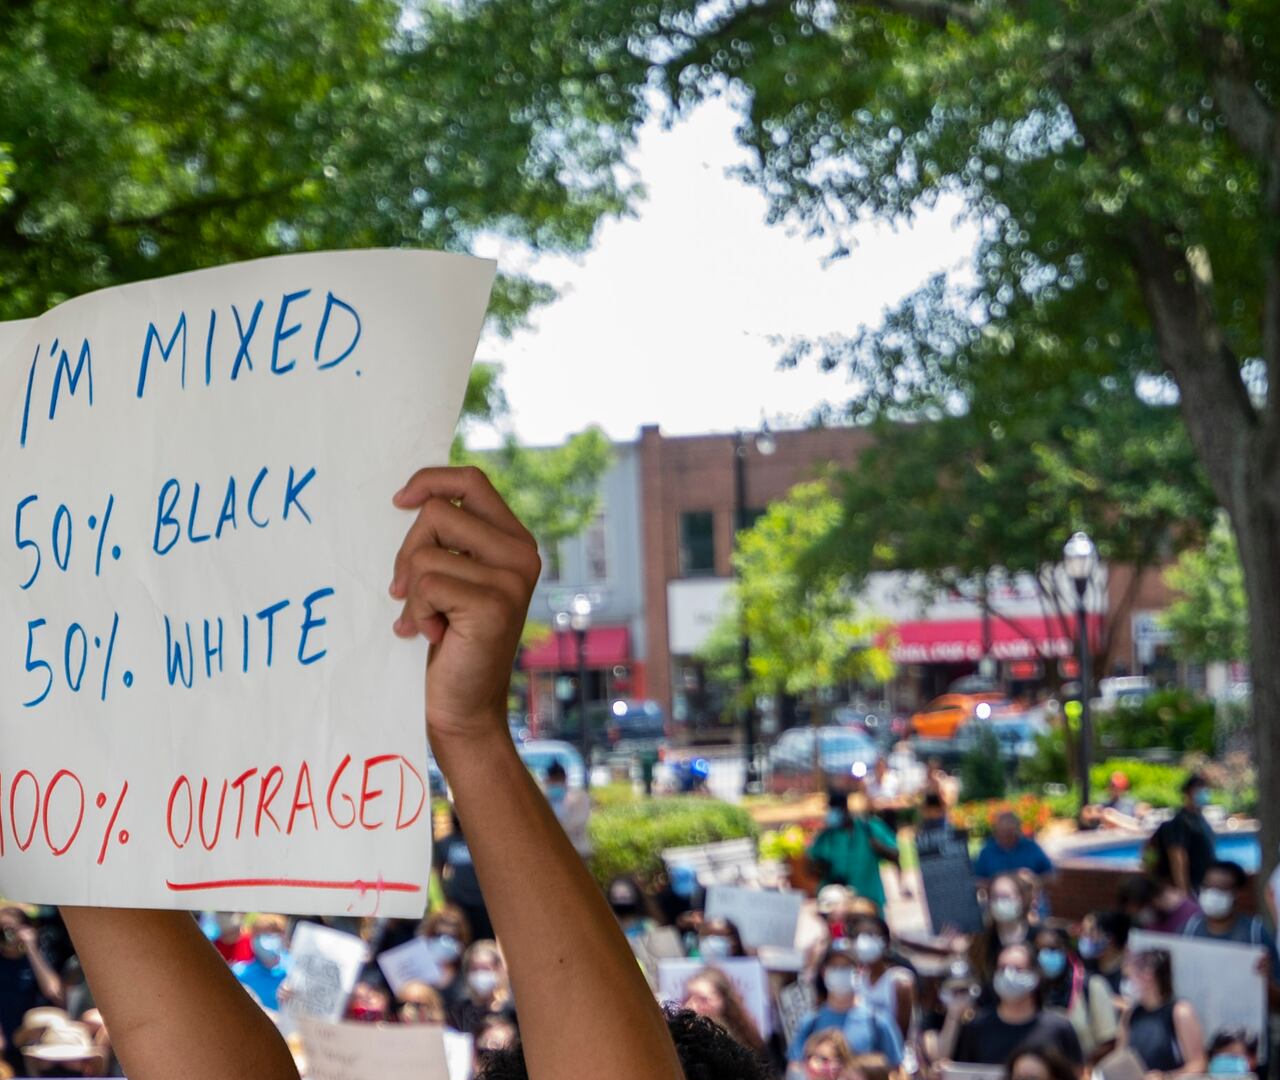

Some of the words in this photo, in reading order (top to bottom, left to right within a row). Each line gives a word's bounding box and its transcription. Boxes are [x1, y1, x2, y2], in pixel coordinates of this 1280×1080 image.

[19, 336, 94, 449] I'M
[136, 288, 363, 399] MIXED.
[15, 493, 122, 590] 50%
[152, 465, 317, 556] BLACK
[22, 611, 134, 708] 50%
[163, 587, 335, 689] WHITE
[166, 753, 426, 852] OUTRAGED
